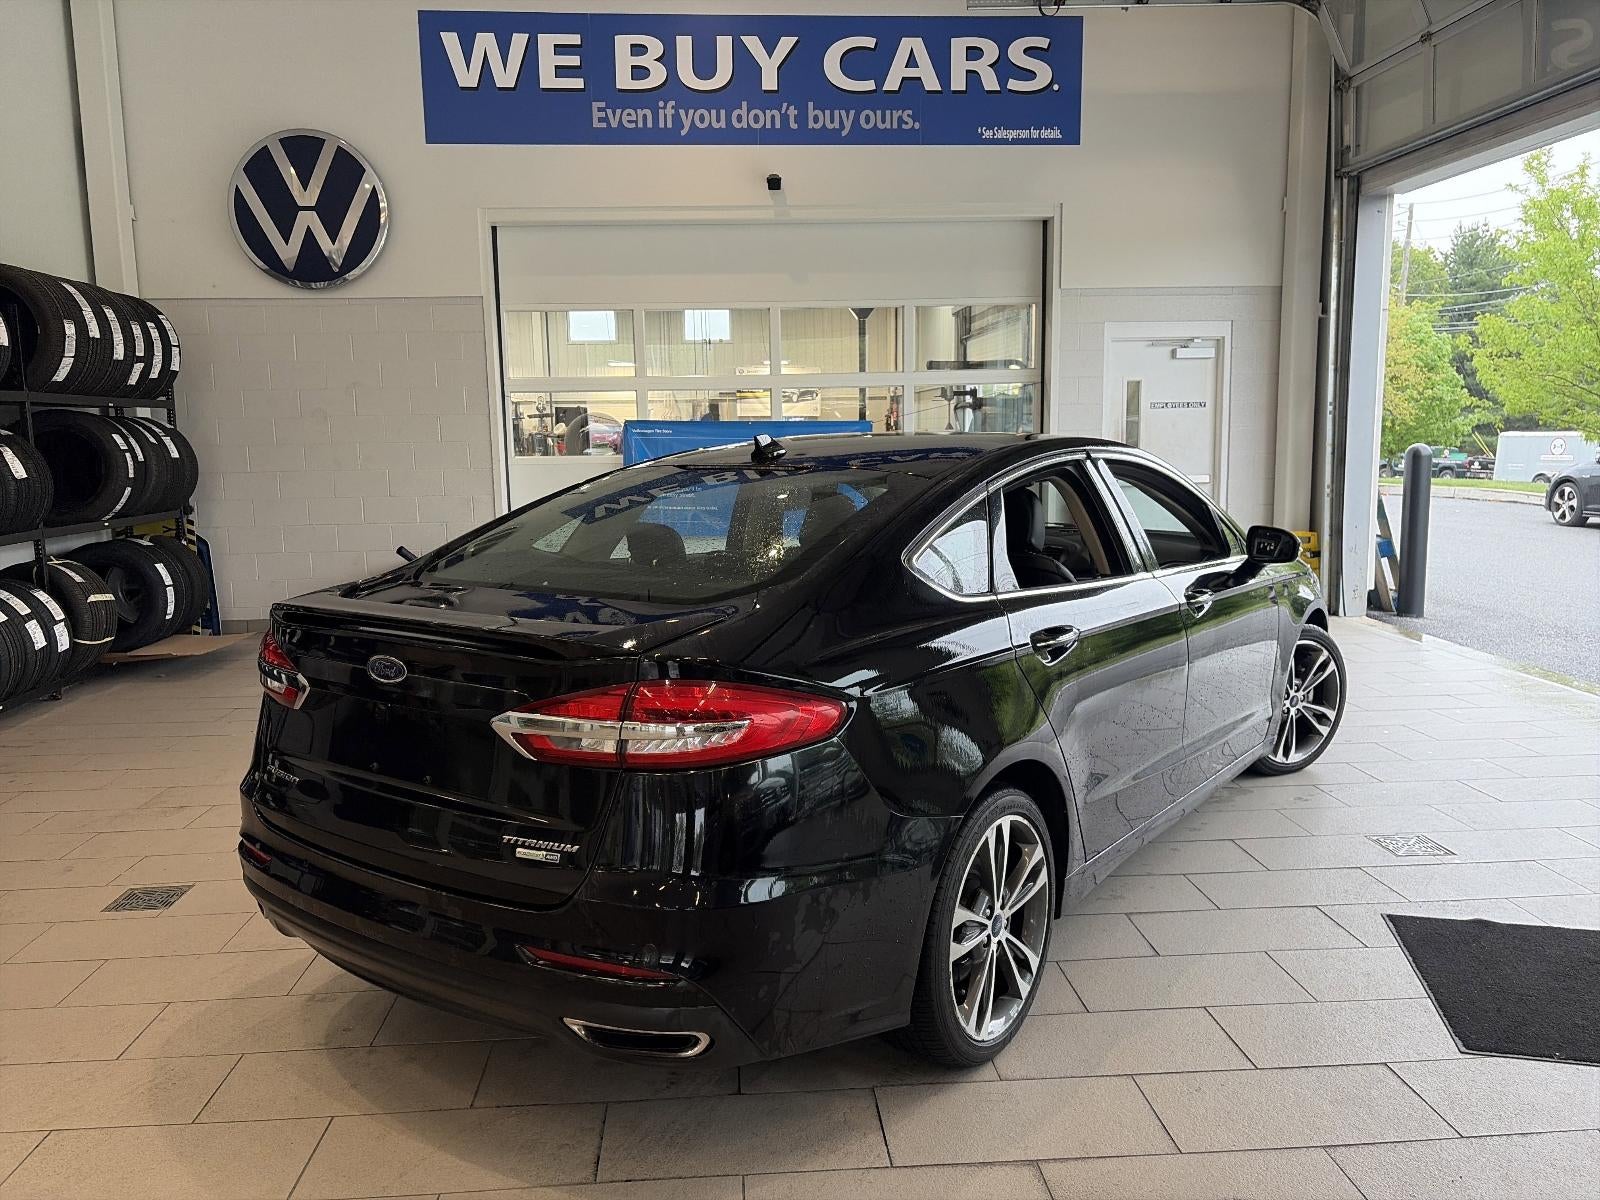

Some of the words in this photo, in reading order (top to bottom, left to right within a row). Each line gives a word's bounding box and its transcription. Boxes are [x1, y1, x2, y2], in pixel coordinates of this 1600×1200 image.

[440, 31, 585, 90] WE
[614, 33, 799, 92] BUY
[823, 36, 1060, 93] CARS.
[591, 101, 653, 129] Even
[658, 100, 677, 128] if
[680, 105, 726, 136] you
[731, 101, 798, 130] don't
[807, 102, 855, 137] buy
[860, 108, 920, 130] ours.
[994, 126, 1029, 141] Salesperson
[1030, 126, 1039, 139] for
[1150, 401, 1188, 409] EMPLOYEES
[1189, 401, 1206, 409] ONLY
[502, 835, 580, 853] TITANIUM
